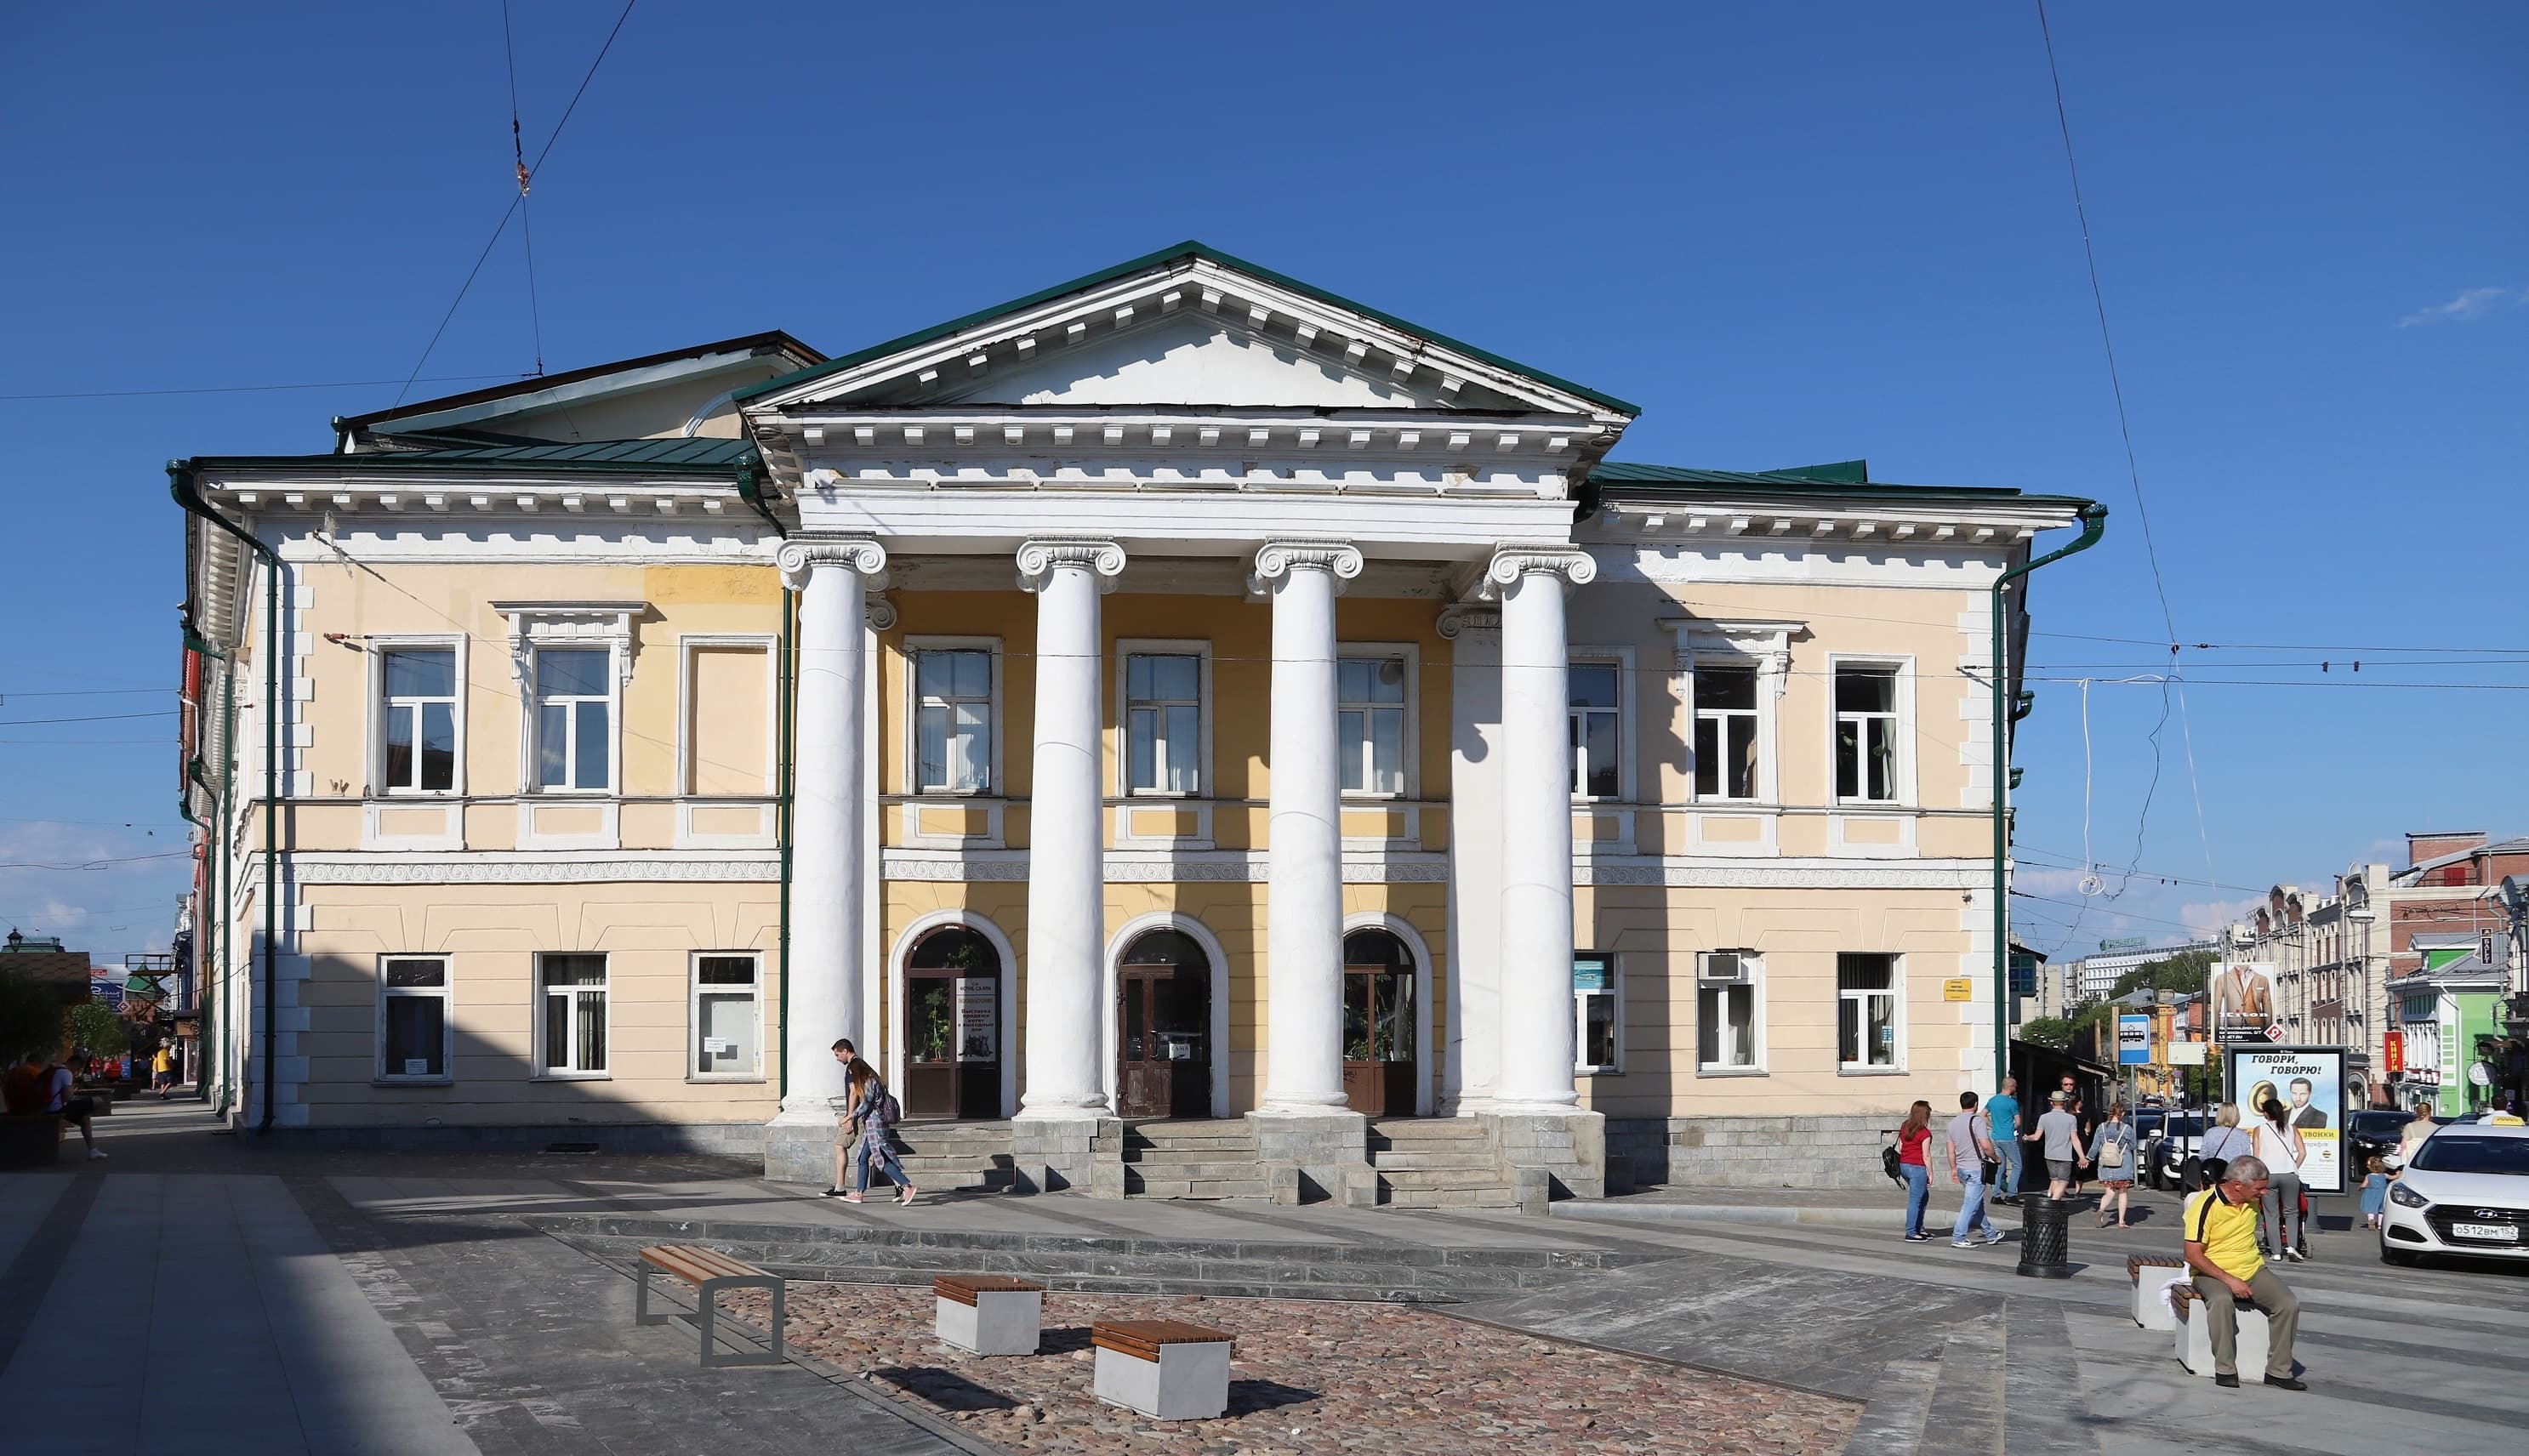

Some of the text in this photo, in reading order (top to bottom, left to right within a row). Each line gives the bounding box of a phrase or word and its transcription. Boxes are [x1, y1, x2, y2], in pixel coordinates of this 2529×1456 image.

[2252, 1055, 2298, 1065] ГОВОРИ,
[2389, 1040, 2398, 1071] КНИГИ
[2270, 1066, 2321, 1075] ГОВОРЮ!
